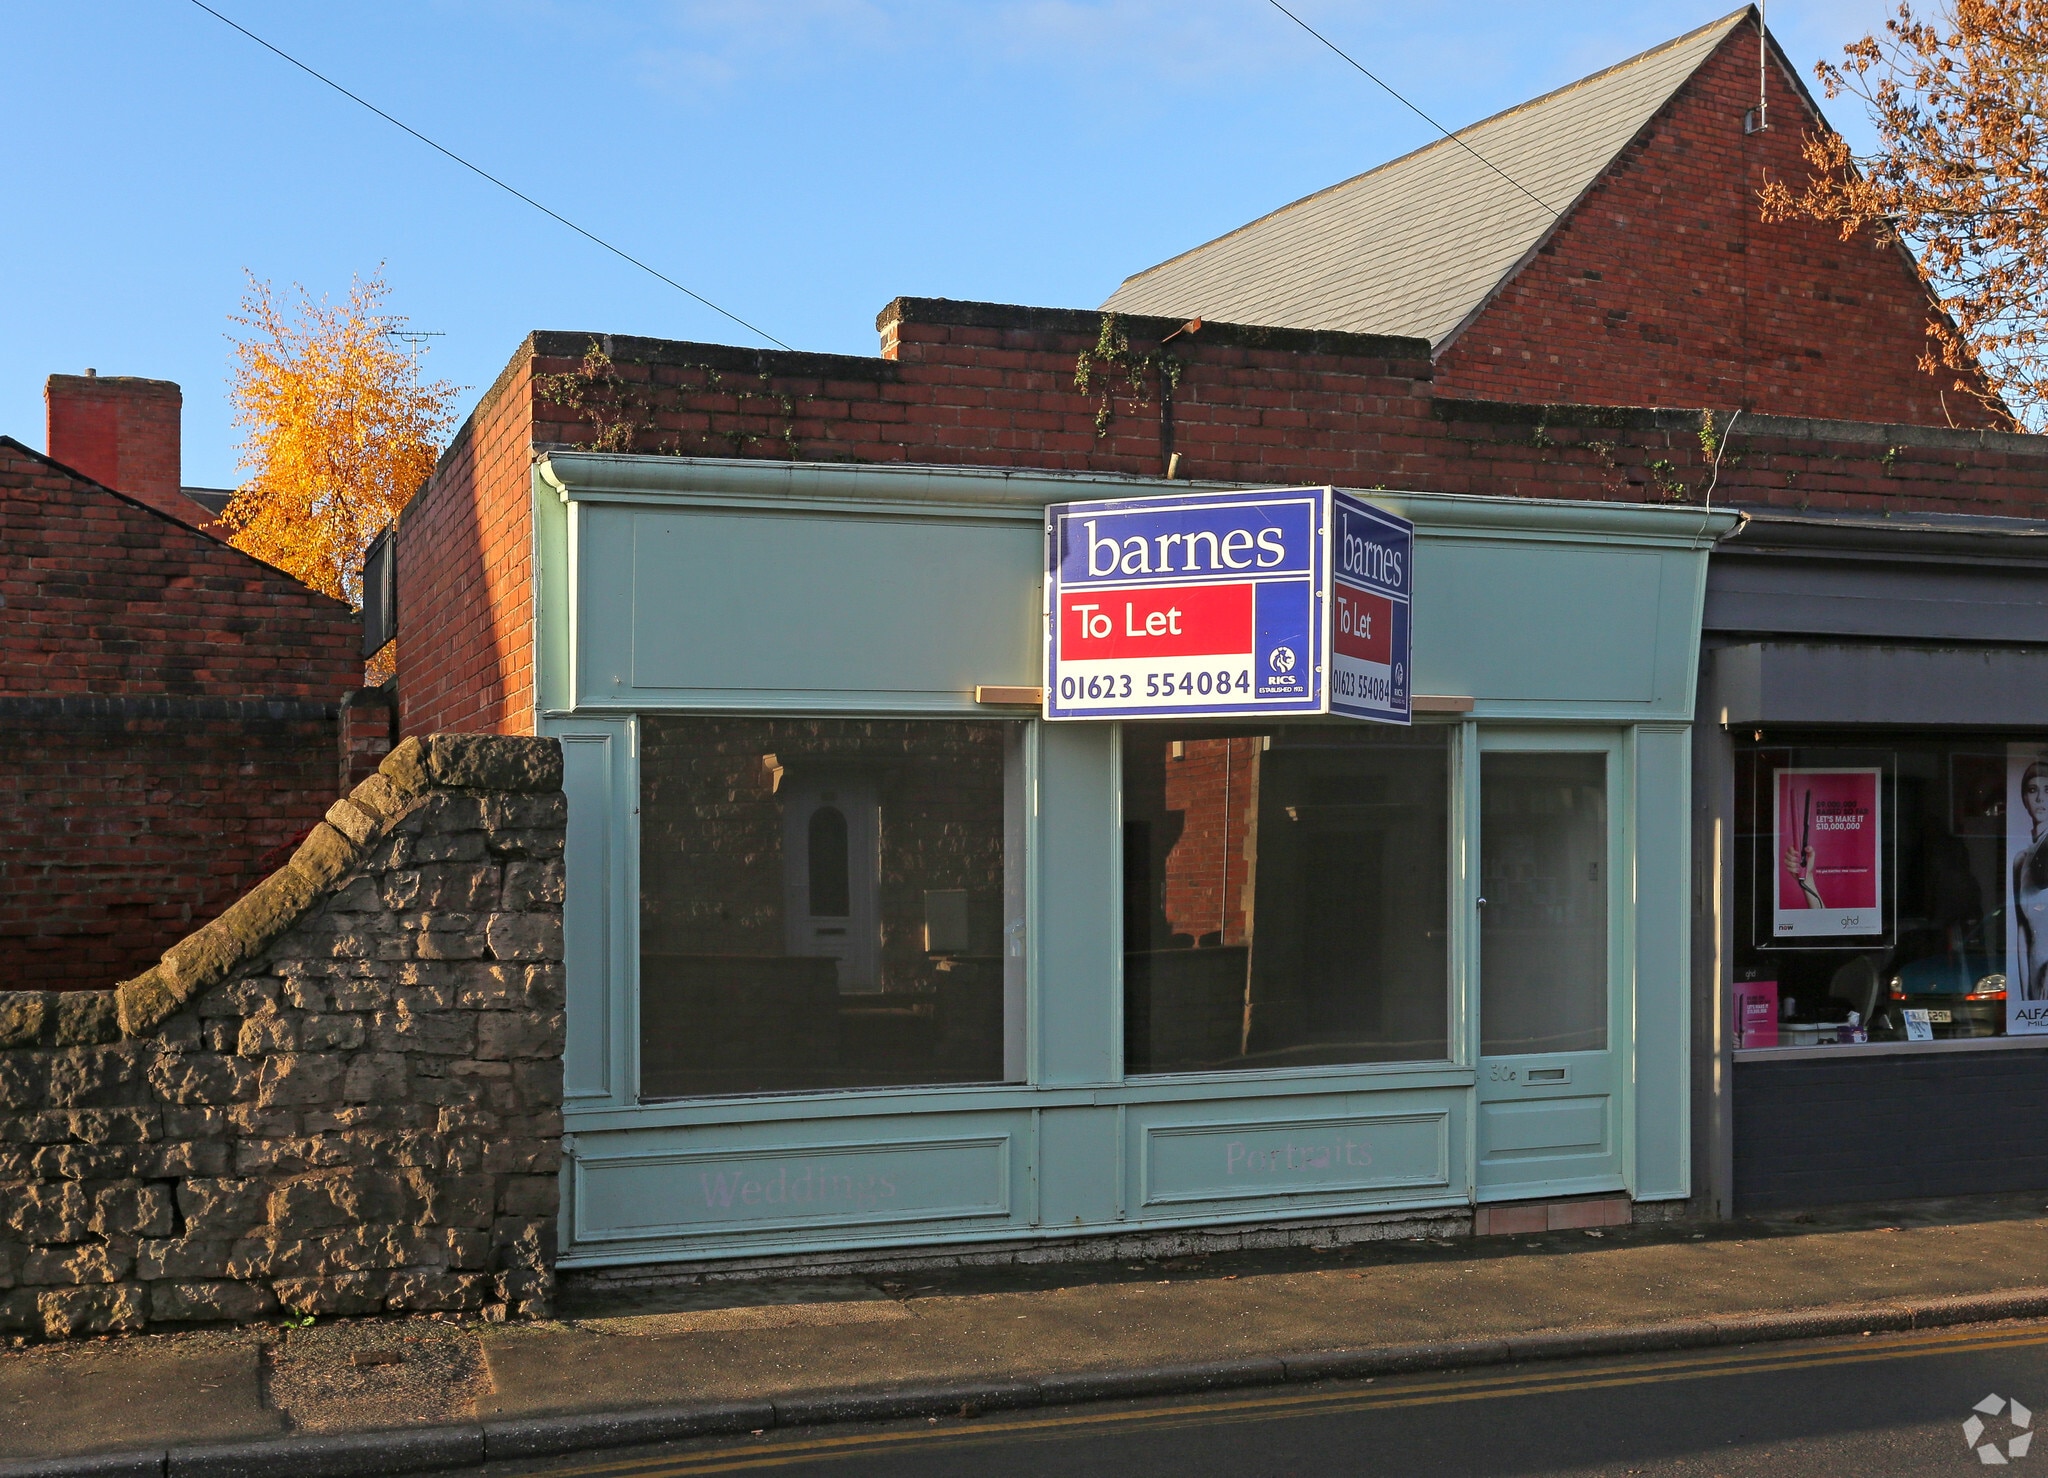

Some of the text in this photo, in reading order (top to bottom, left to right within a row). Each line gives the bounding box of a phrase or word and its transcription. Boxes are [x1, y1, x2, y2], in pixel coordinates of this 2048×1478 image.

[1083, 519, 1286, 577] barnes
[1342, 513, 1402, 587] barnes
[1071, 602, 1182, 639] To Let
[1337, 596, 1372, 640] To Let
[1061, 670, 1250, 700] 01623 554084
[1268, 675, 1297, 685] RICS
[1333, 669, 1390, 702] 01623 554084
[1816, 815, 1864, 823] LET'S MAKE IT
[1840, 915, 1859, 930] ghd
[1226, 1136, 1374, 1175] Portraits
[700, 1166, 897, 1209] Weddings
